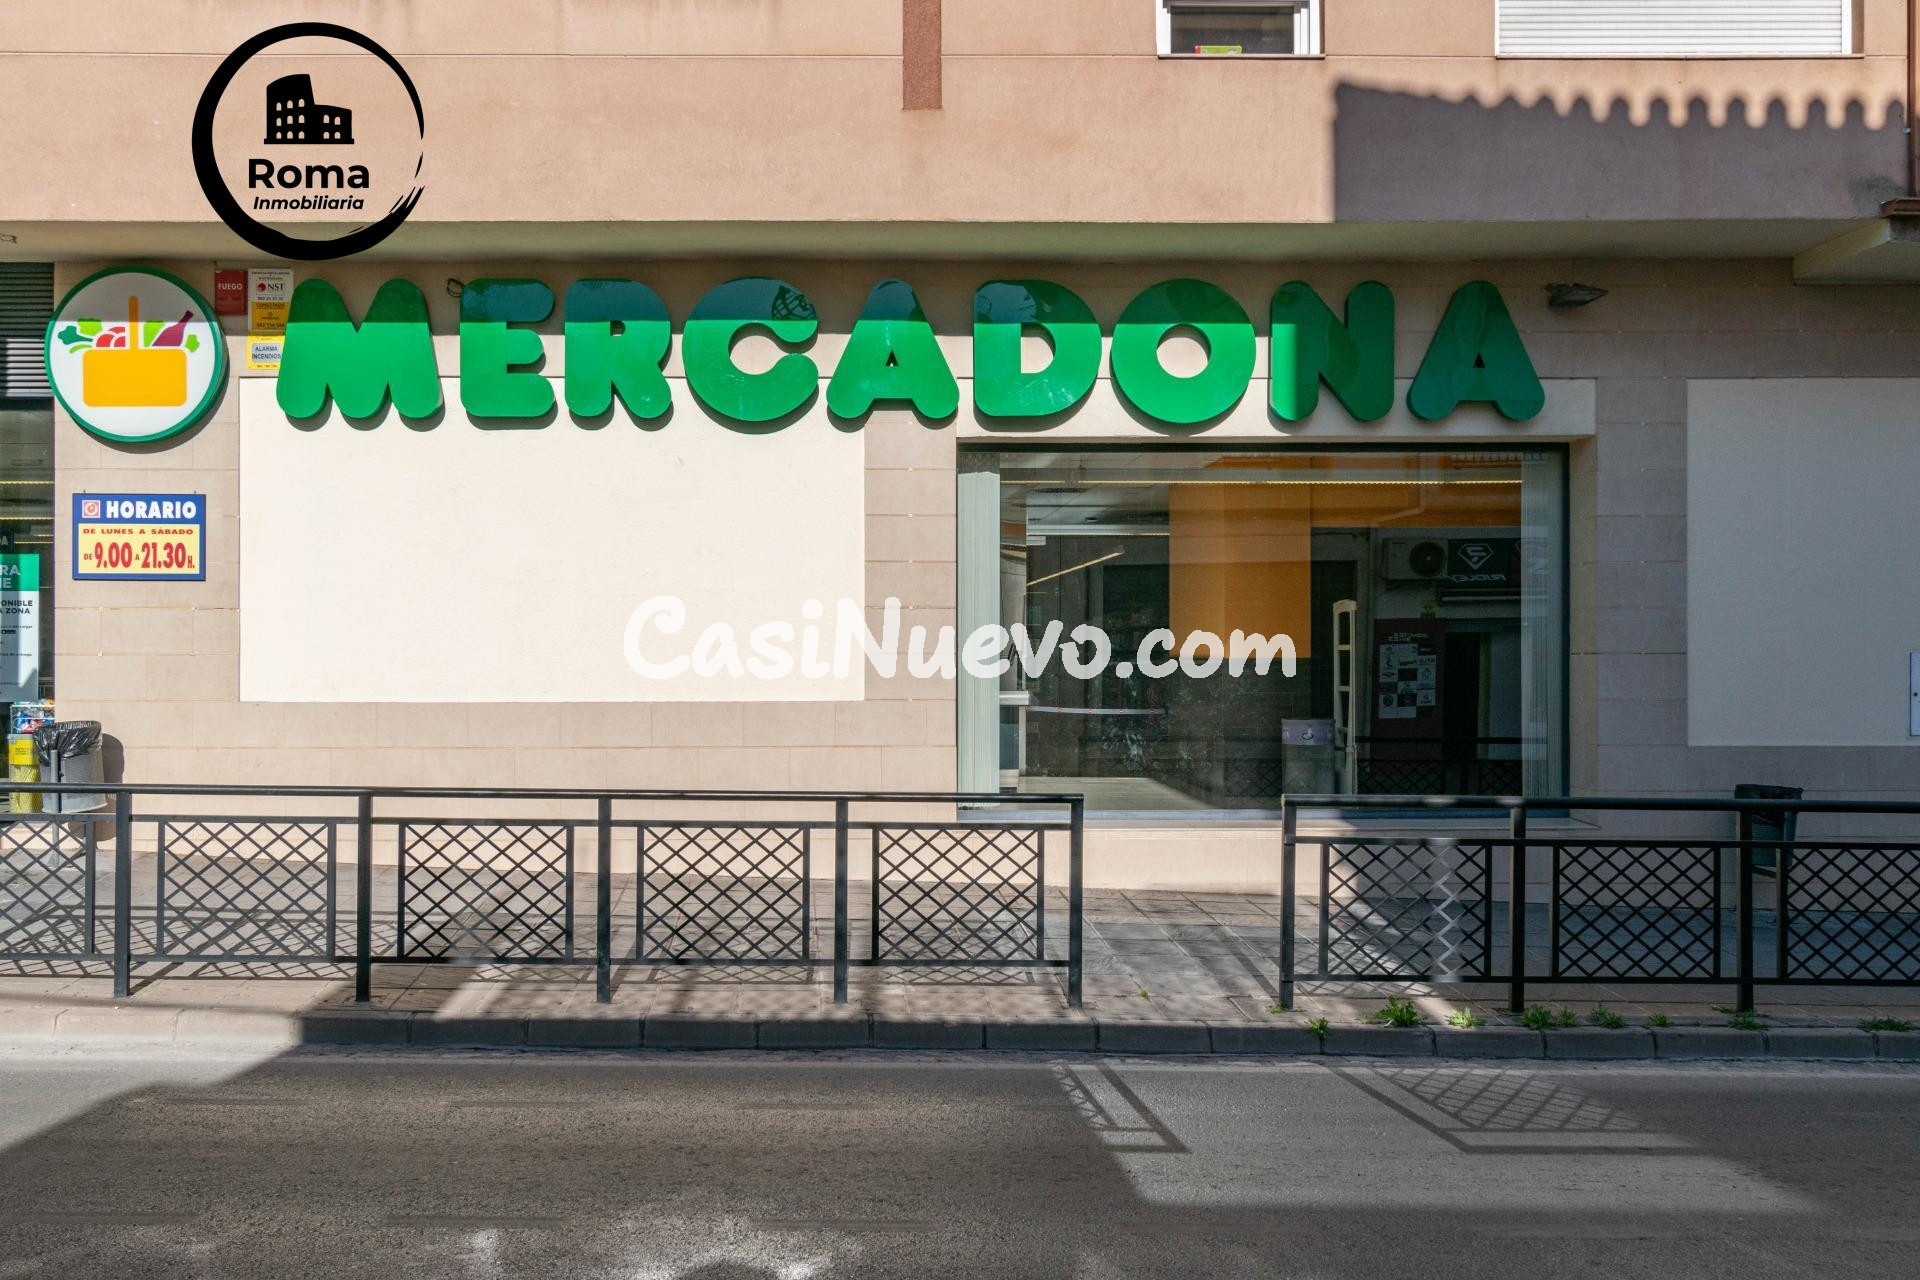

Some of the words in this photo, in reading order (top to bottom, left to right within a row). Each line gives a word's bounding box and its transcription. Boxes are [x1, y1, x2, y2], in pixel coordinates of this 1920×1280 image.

[276, 277, 1546, 424] MERCADONA
[106, 500, 197, 519] HORARIO
[151, 527, 194, 535] SÁBADO
[83, 553, 93, 561] DE
[94, 541, 133, 568] 9.00
[135, 553, 140, 561] A
[141, 541, 186, 569] 21.30
[187, 555, 195, 569] H.
